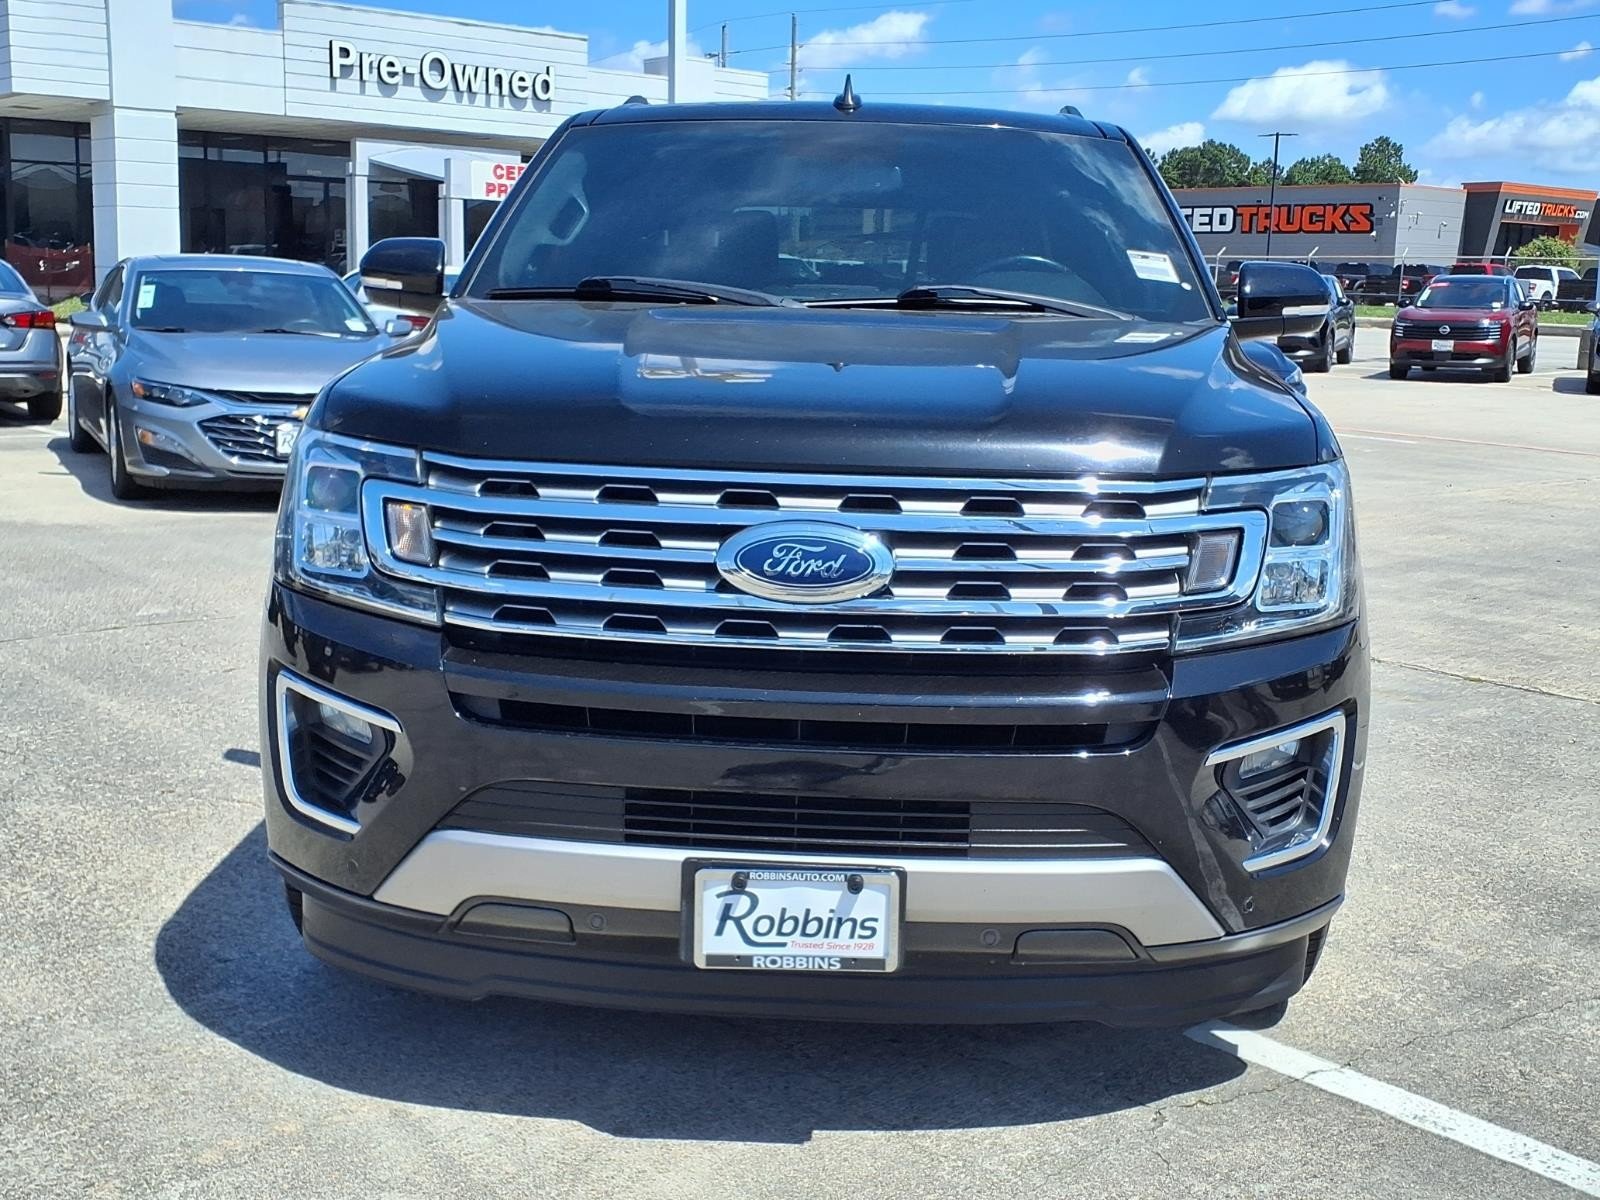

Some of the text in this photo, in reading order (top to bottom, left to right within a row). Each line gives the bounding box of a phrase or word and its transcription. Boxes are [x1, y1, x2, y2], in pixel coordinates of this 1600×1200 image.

[329, 39, 555, 101] Pre-Owned
[1180, 207, 1234, 232] ED
[763, 543, 847, 579] Ford
[749, 871, 846, 883] ROBBINSAUTO.COM
[714, 890, 880, 948] Robbins
[790, 940, 876, 952] Trusted Since 1928
[752, 955, 842, 970] ROBBINS
